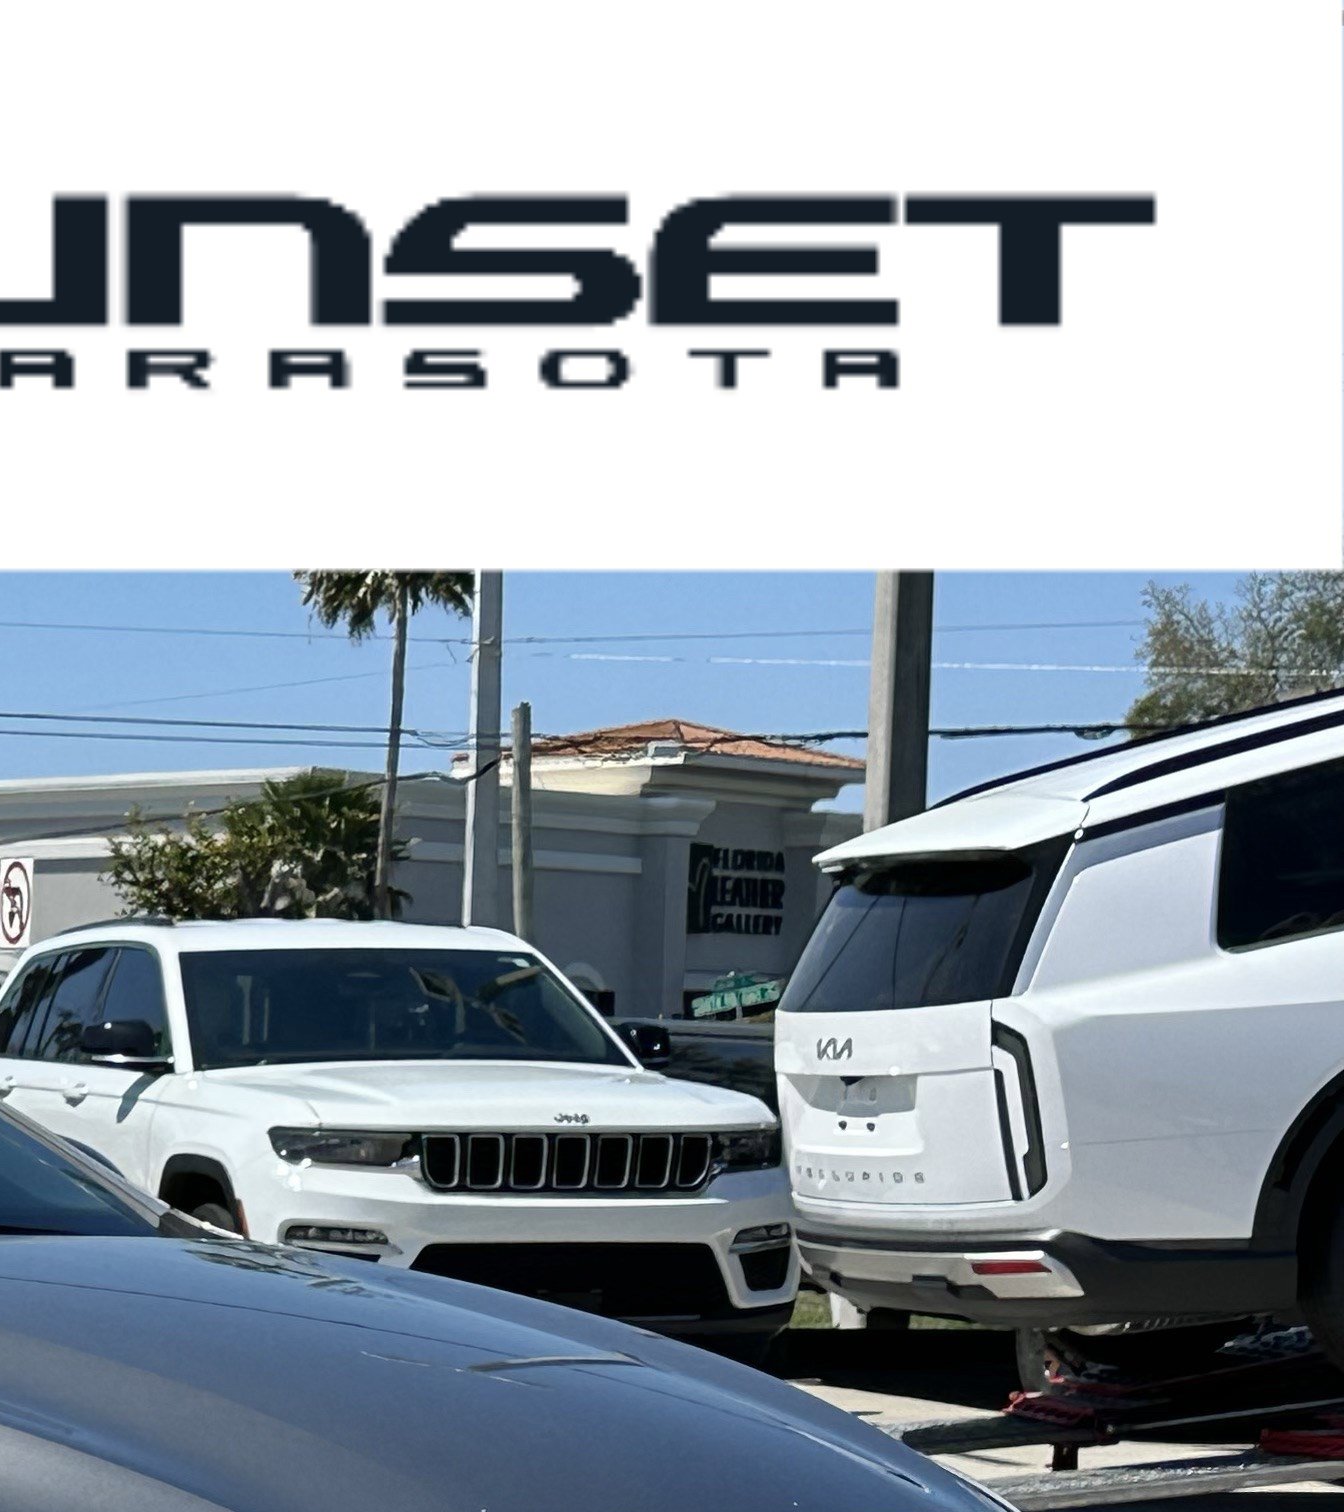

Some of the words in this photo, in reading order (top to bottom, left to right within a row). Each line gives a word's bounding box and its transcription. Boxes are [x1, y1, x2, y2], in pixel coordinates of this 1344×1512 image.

[713, 848, 785, 873] FLORIDA
[712, 876, 785, 909] LEATHER
[816, 1037, 853, 1061] KIA
